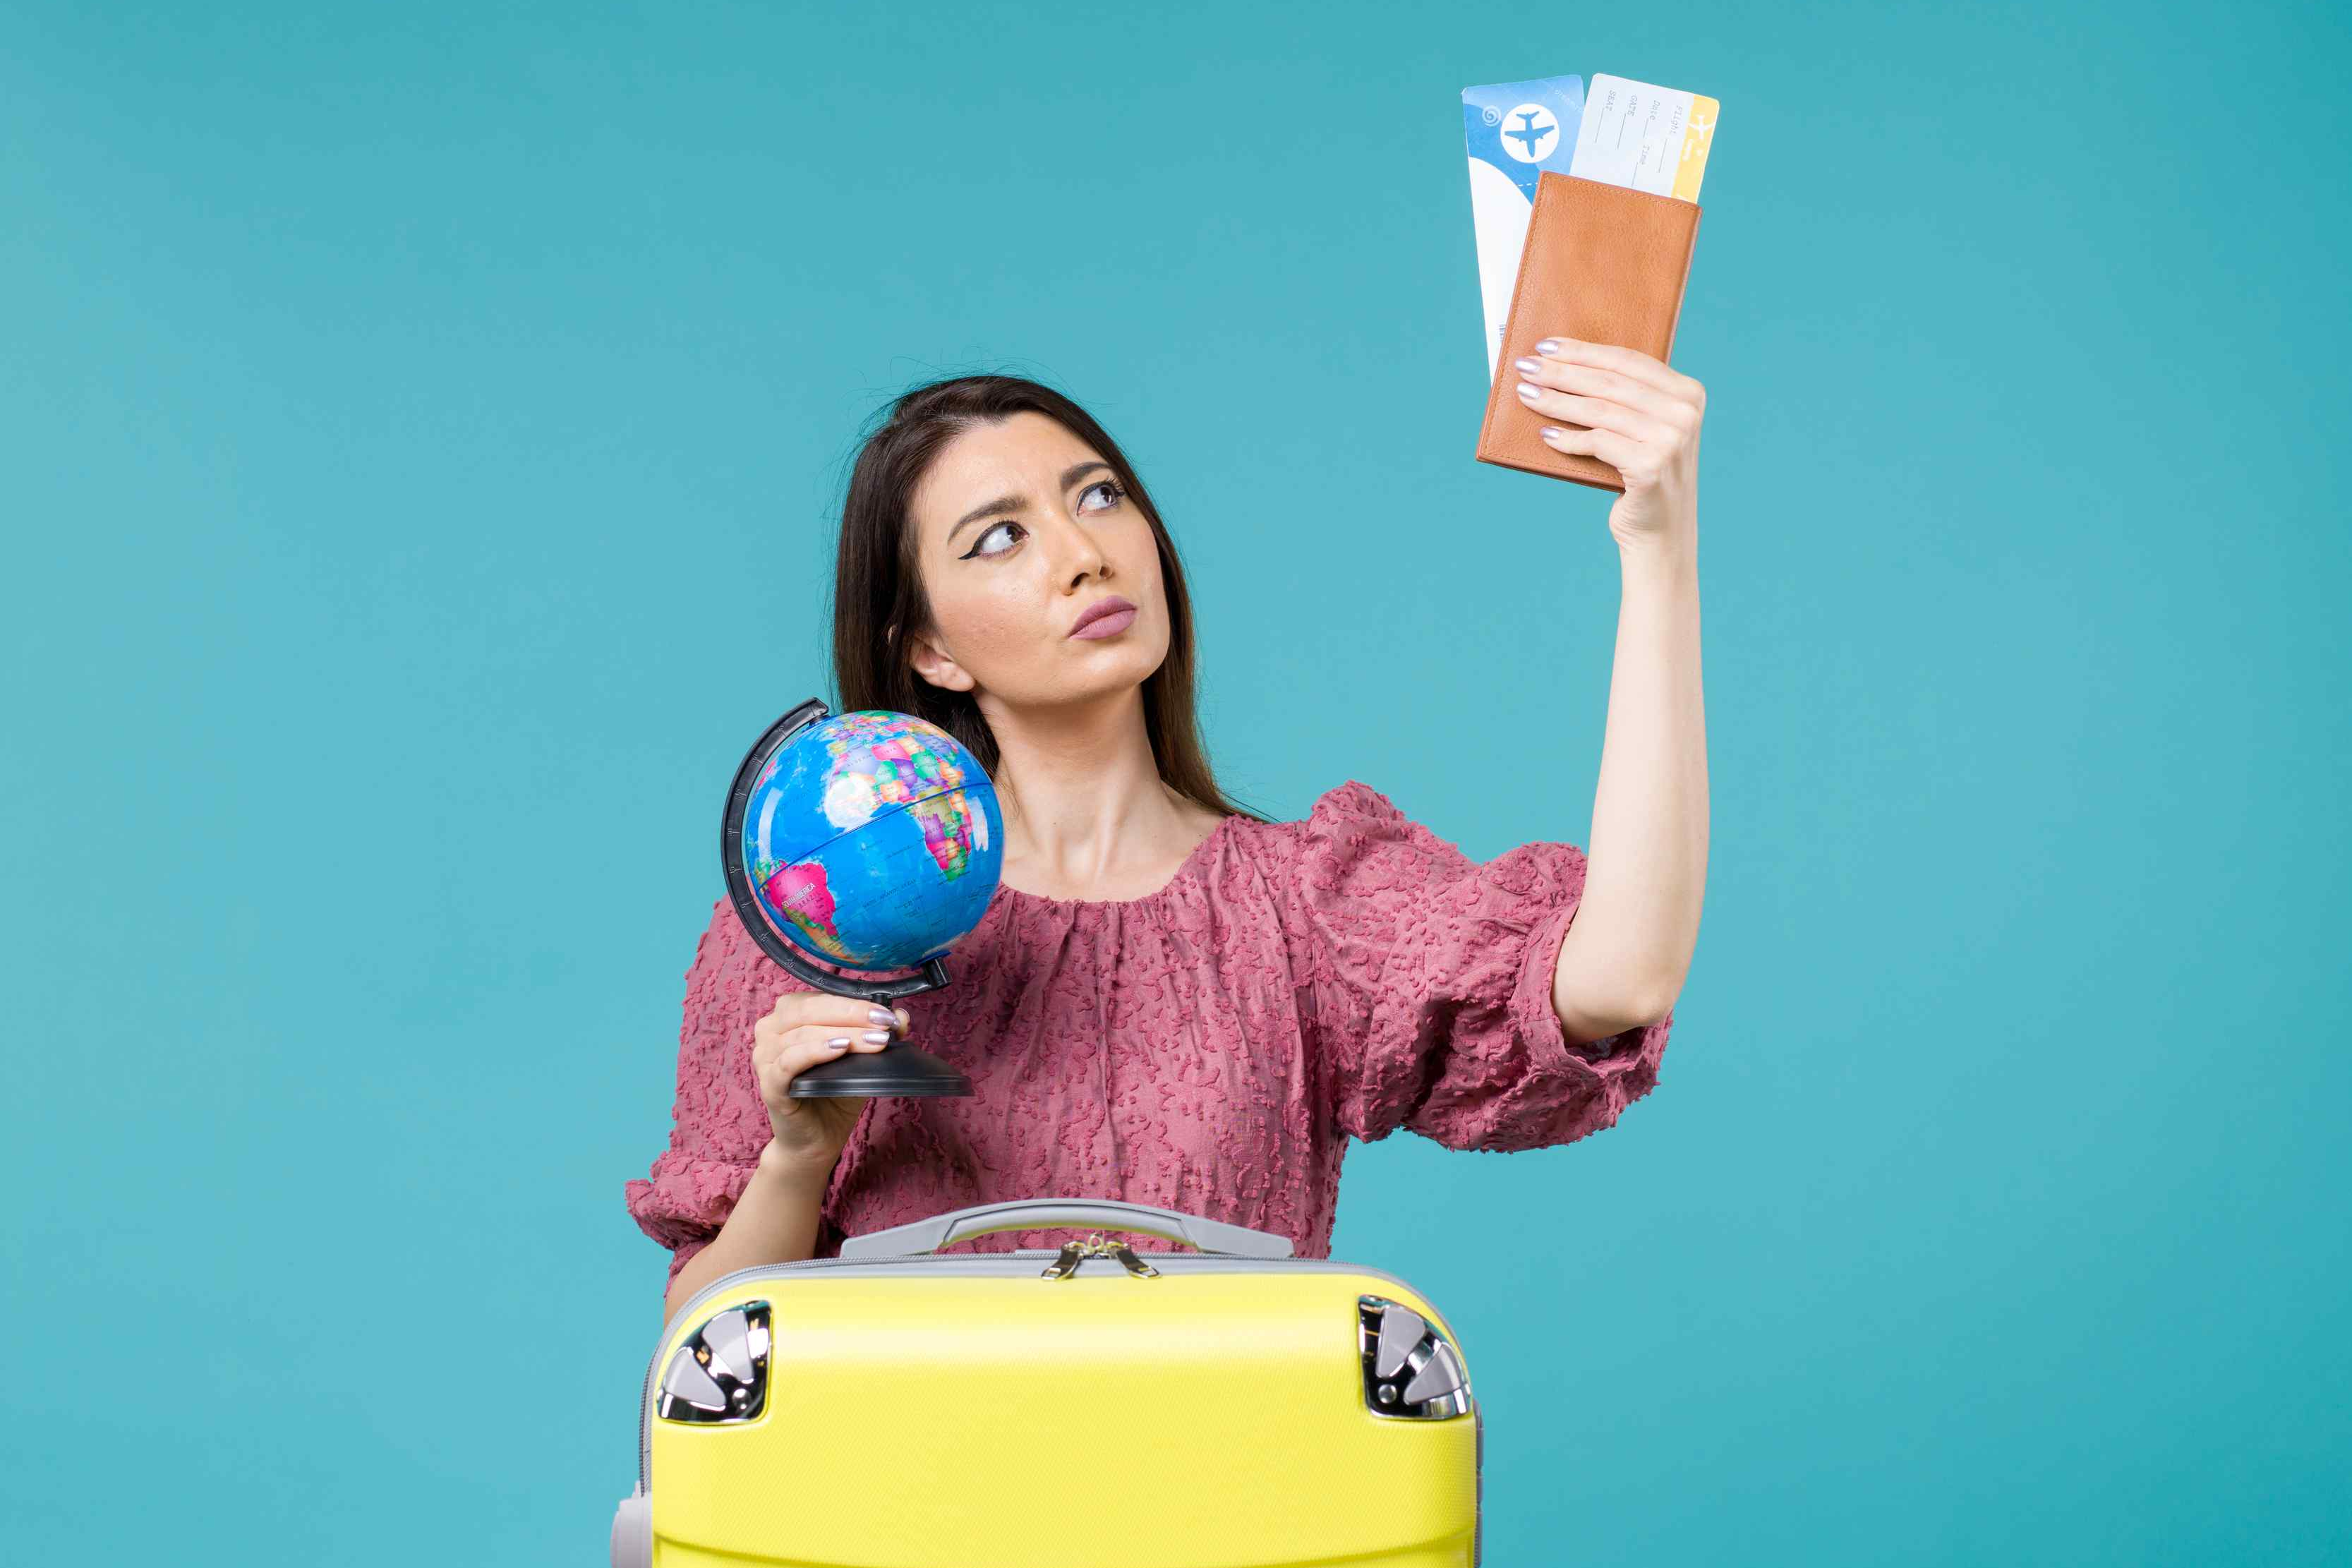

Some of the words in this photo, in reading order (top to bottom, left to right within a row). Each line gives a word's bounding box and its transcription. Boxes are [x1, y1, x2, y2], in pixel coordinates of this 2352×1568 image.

[1604, 90, 1617, 111] SEAT
[1627, 95, 1639, 116] GATE
[1649, 99, 1660, 122] Date
[1670, 104, 1684, 135] Flight
[1639, 144, 1651, 165] Time
